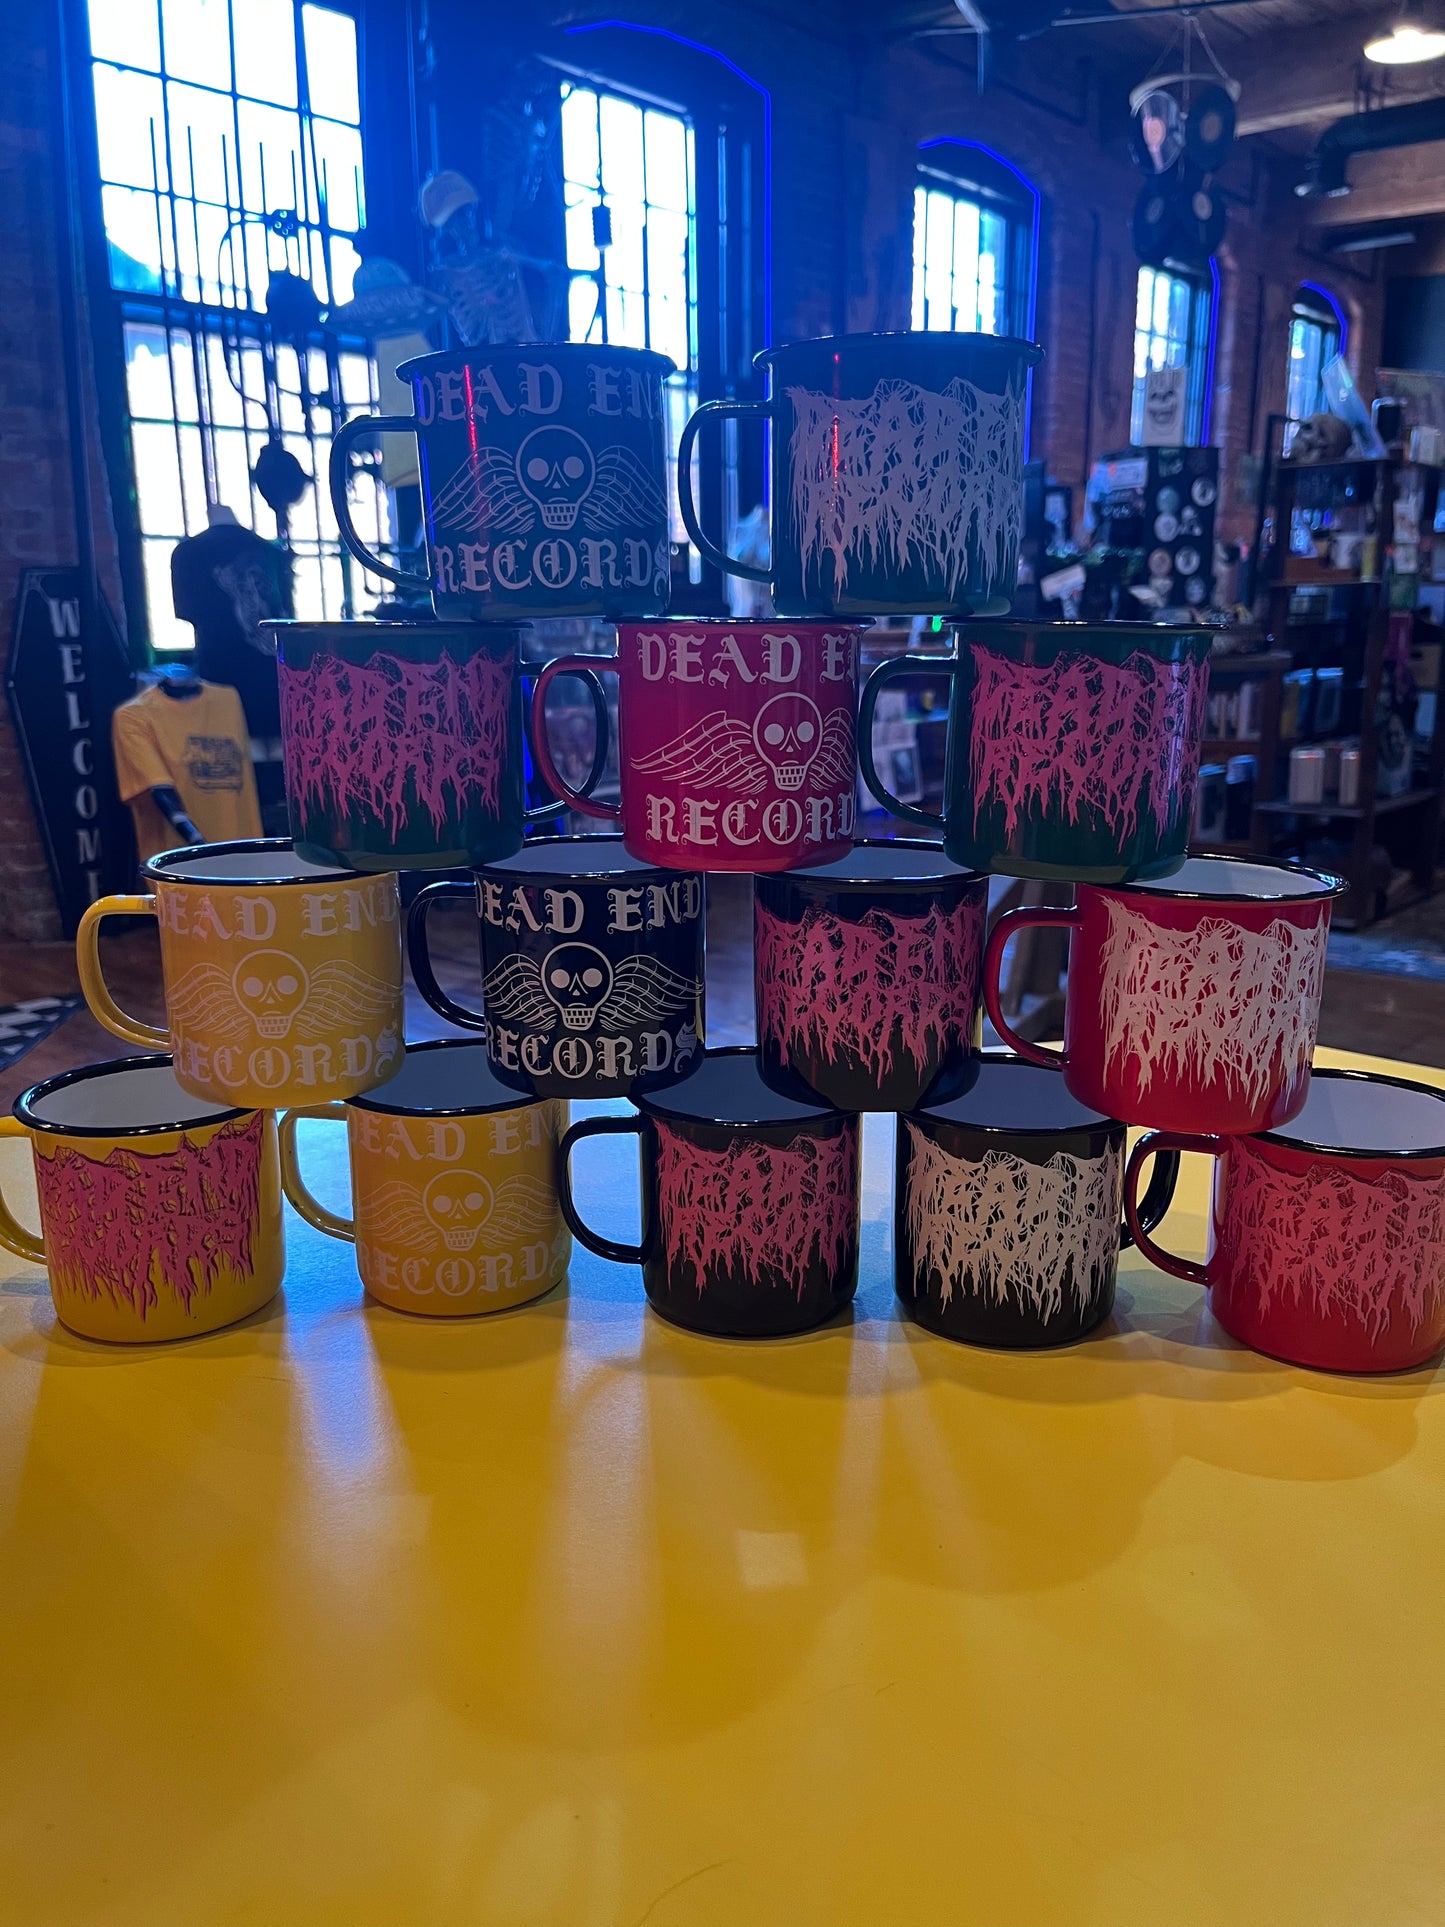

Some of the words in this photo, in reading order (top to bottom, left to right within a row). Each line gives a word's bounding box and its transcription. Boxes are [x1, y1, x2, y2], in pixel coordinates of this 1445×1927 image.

[586, 363, 664, 423] EN
[433, 537, 671, 597] RECORDS
[636, 632, 802, 690] DEAD
[606, 875, 700, 935] END
